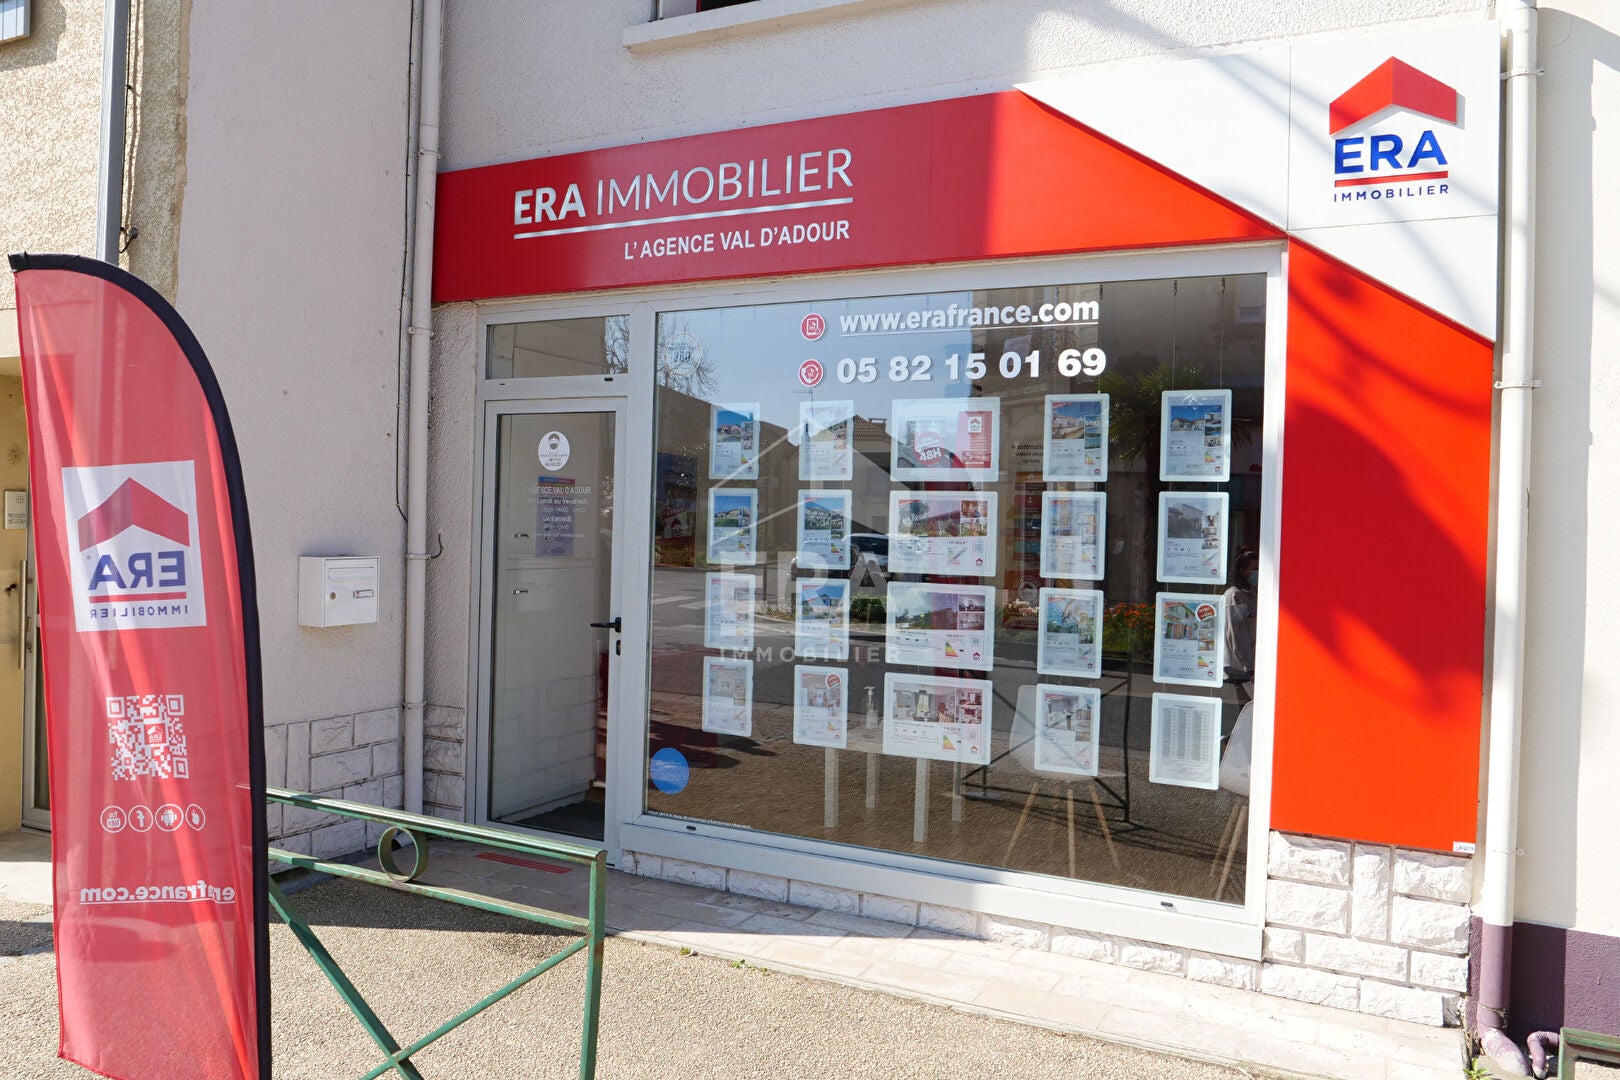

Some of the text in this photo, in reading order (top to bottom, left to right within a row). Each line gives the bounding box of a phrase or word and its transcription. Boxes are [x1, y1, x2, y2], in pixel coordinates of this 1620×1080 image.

[1334, 130, 1448, 174] ERA
[513, 148, 853, 225] ERA IMMOBILIER
[1334, 184, 1448, 202] IMMOBILIER
[624, 219, 850, 260] L'AGENCE VAL D'ADOUR
[840, 301, 1099, 333] www.erafrance.com
[836, 348, 1106, 384] 05 82 15 01 69
